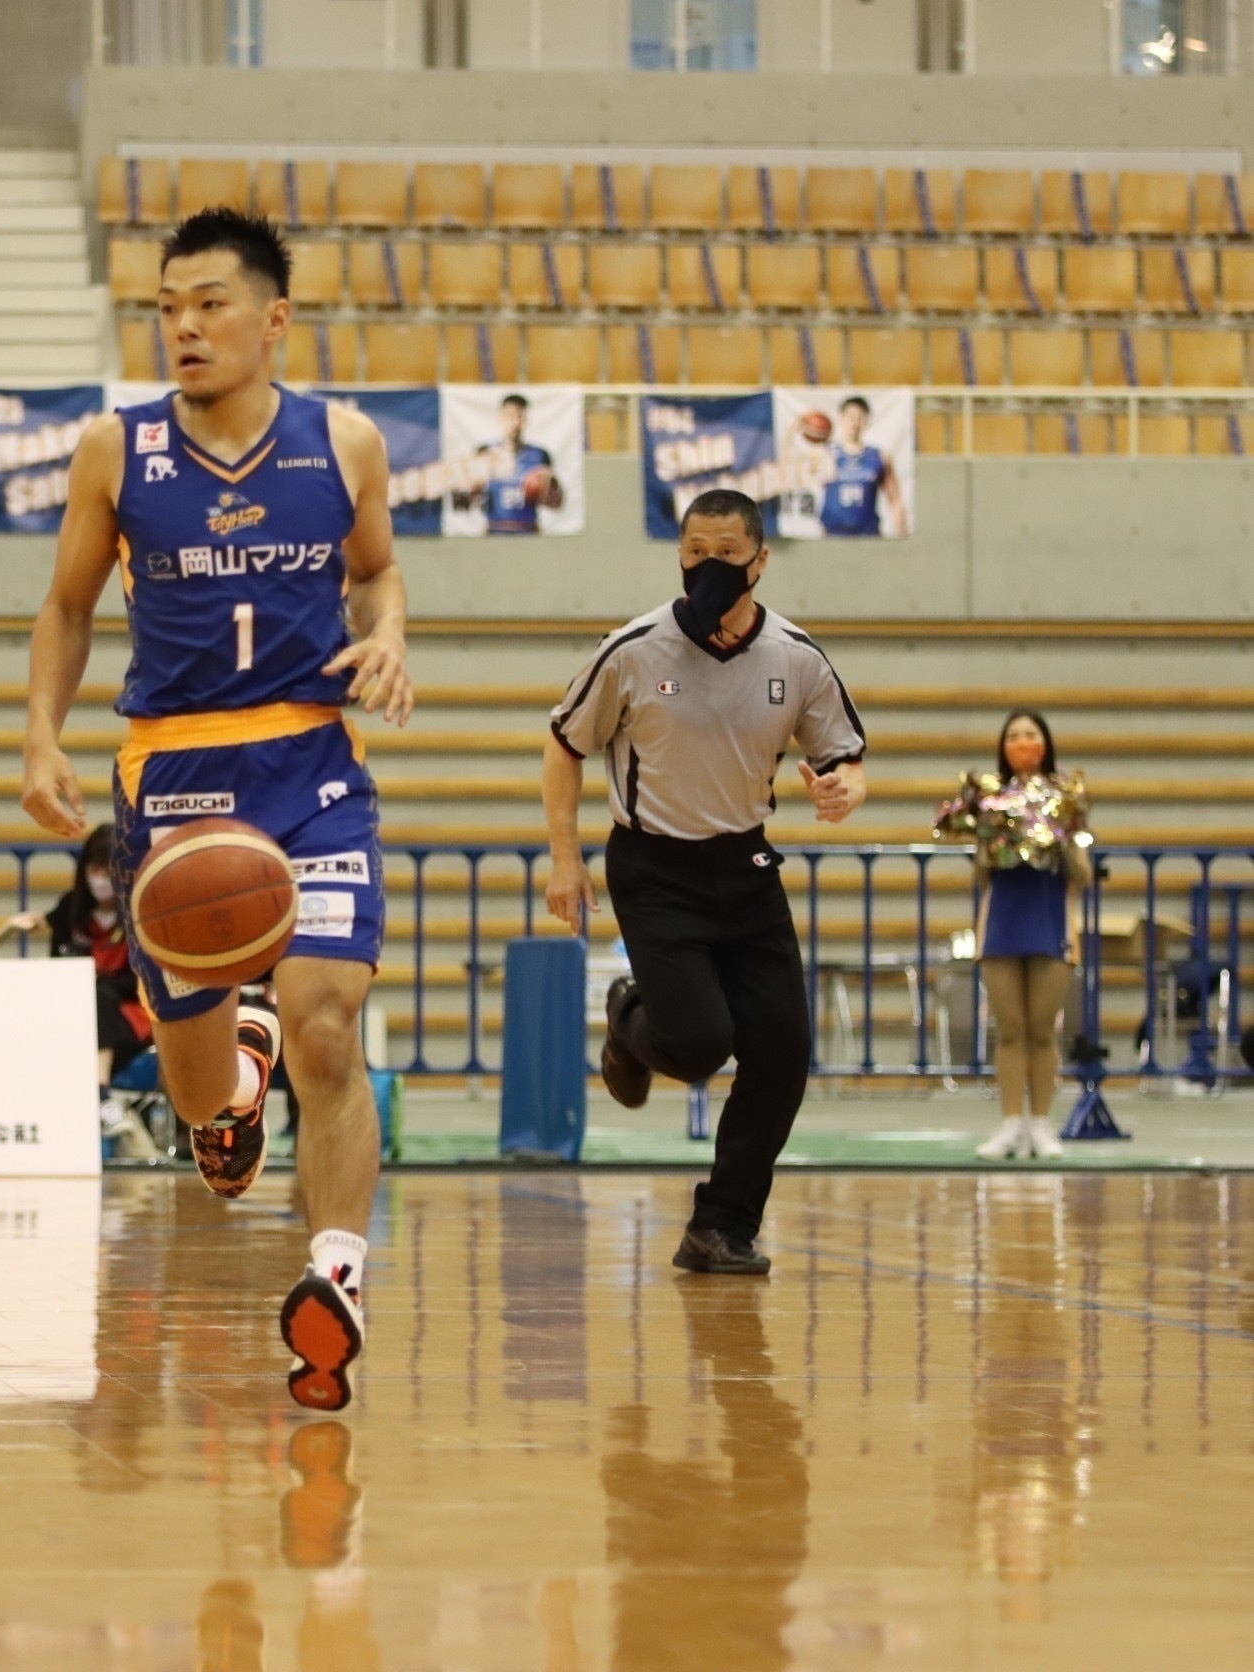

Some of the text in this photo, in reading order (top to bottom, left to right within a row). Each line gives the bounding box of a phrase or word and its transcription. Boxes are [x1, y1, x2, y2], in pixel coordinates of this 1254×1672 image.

[179, 543, 333, 578] 岡山マツダ
[232, 603, 254, 671] 1
